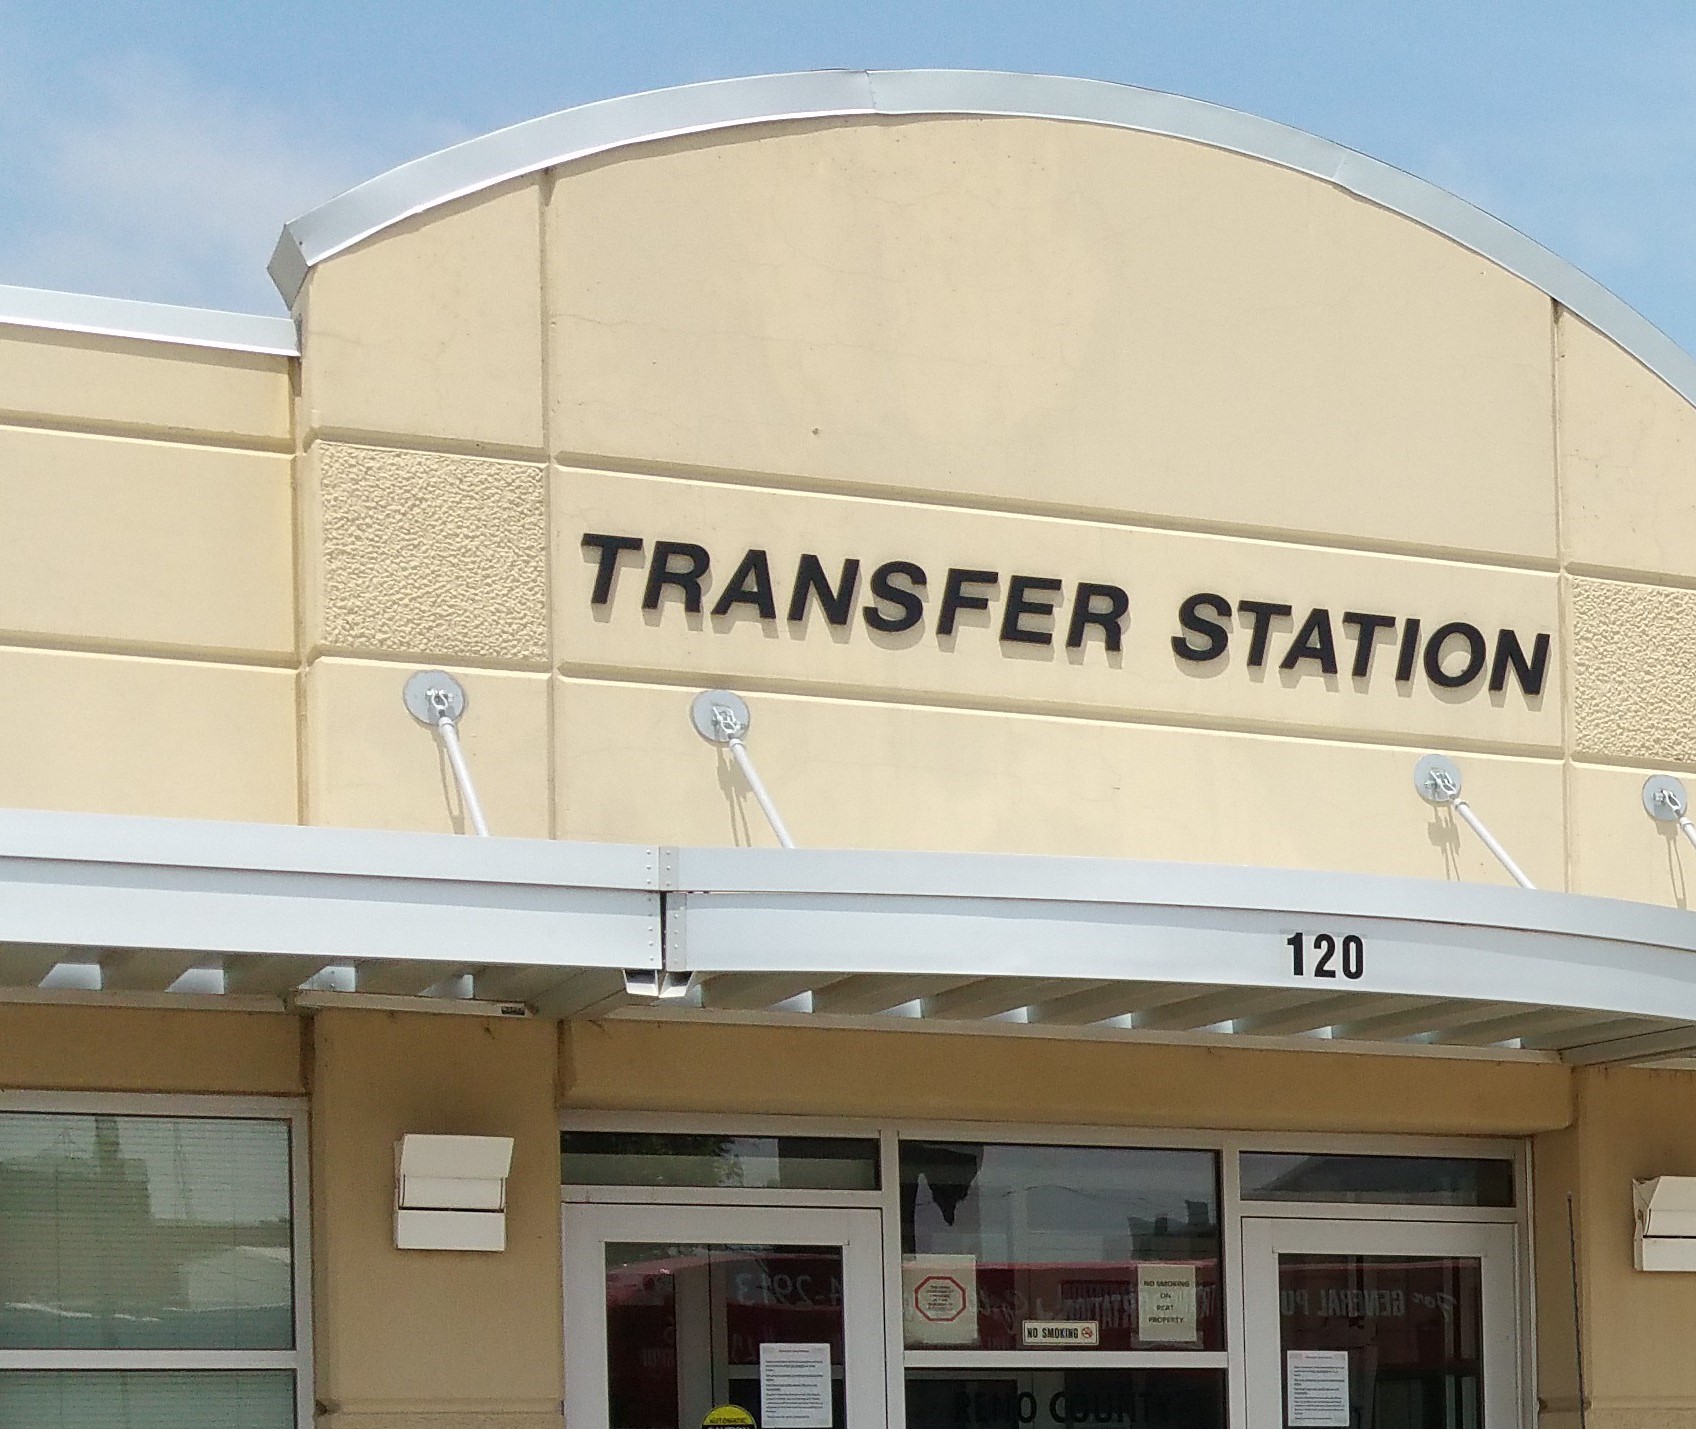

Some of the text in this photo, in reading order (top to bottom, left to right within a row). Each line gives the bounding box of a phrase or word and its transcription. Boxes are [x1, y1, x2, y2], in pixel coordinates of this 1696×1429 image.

[581, 532, 1550, 696] TRANSFER STATION
[1287, 932, 1363, 979] 120
[1026, 1327, 1079, 1339] NO SMOKING
